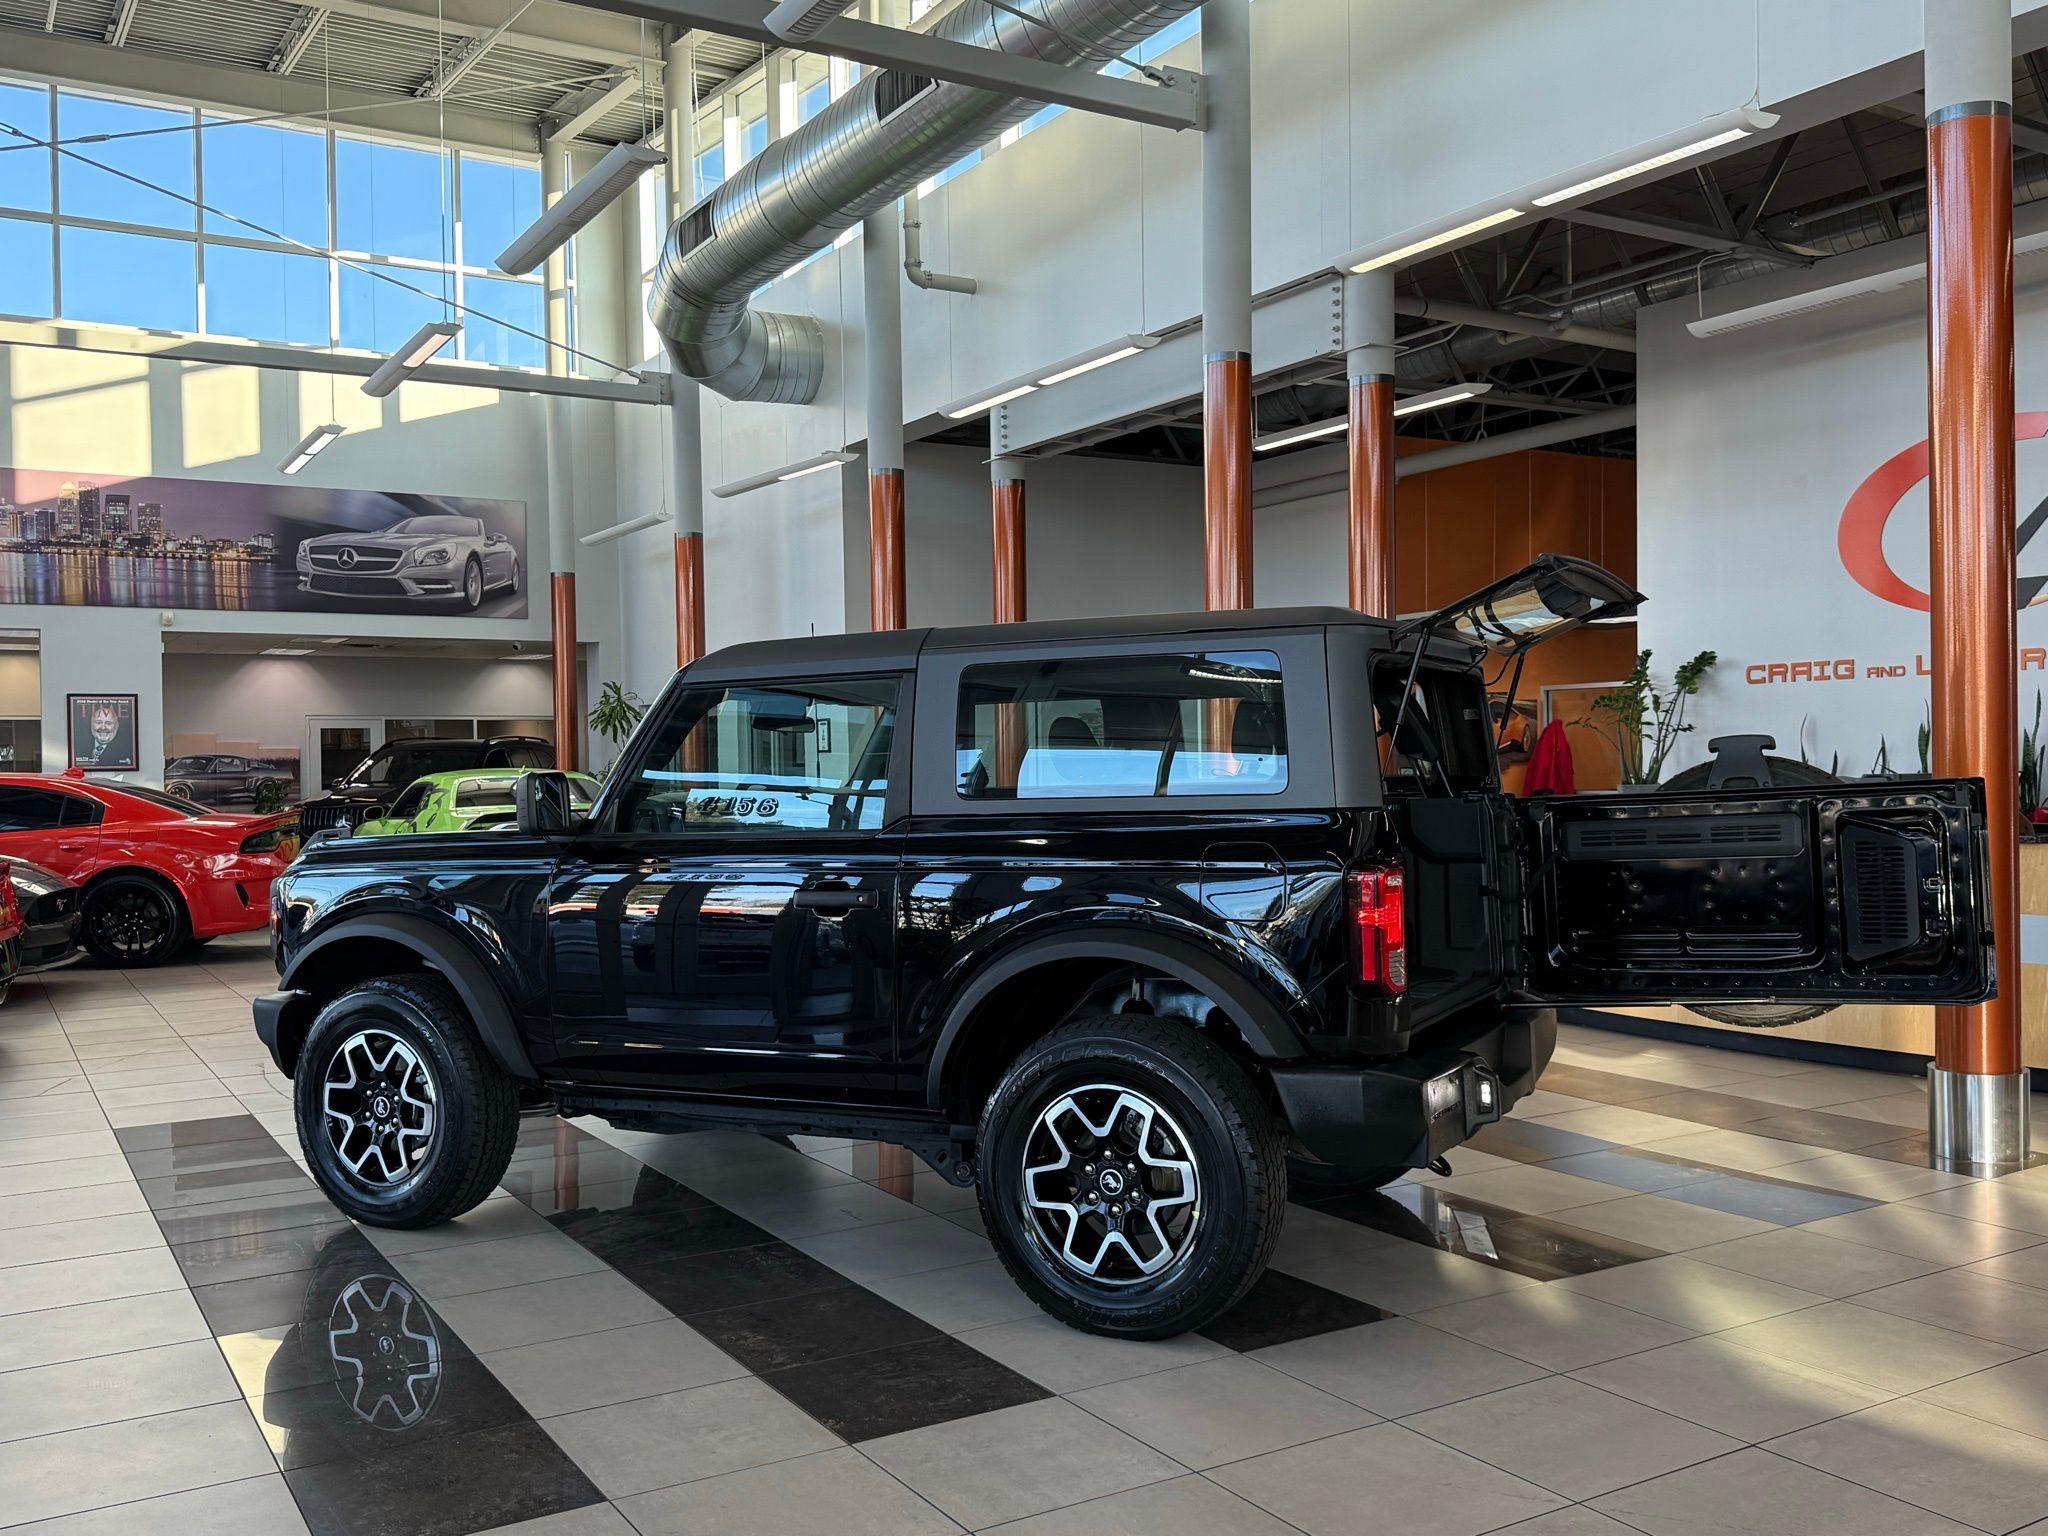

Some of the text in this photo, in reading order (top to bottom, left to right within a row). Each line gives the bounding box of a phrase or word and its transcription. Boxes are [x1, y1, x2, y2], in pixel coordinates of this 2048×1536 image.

[1745, 659, 1906, 685] CRAIG AND
[77, 703, 129, 719] TIME
[697, 796, 779, 818] 4156
